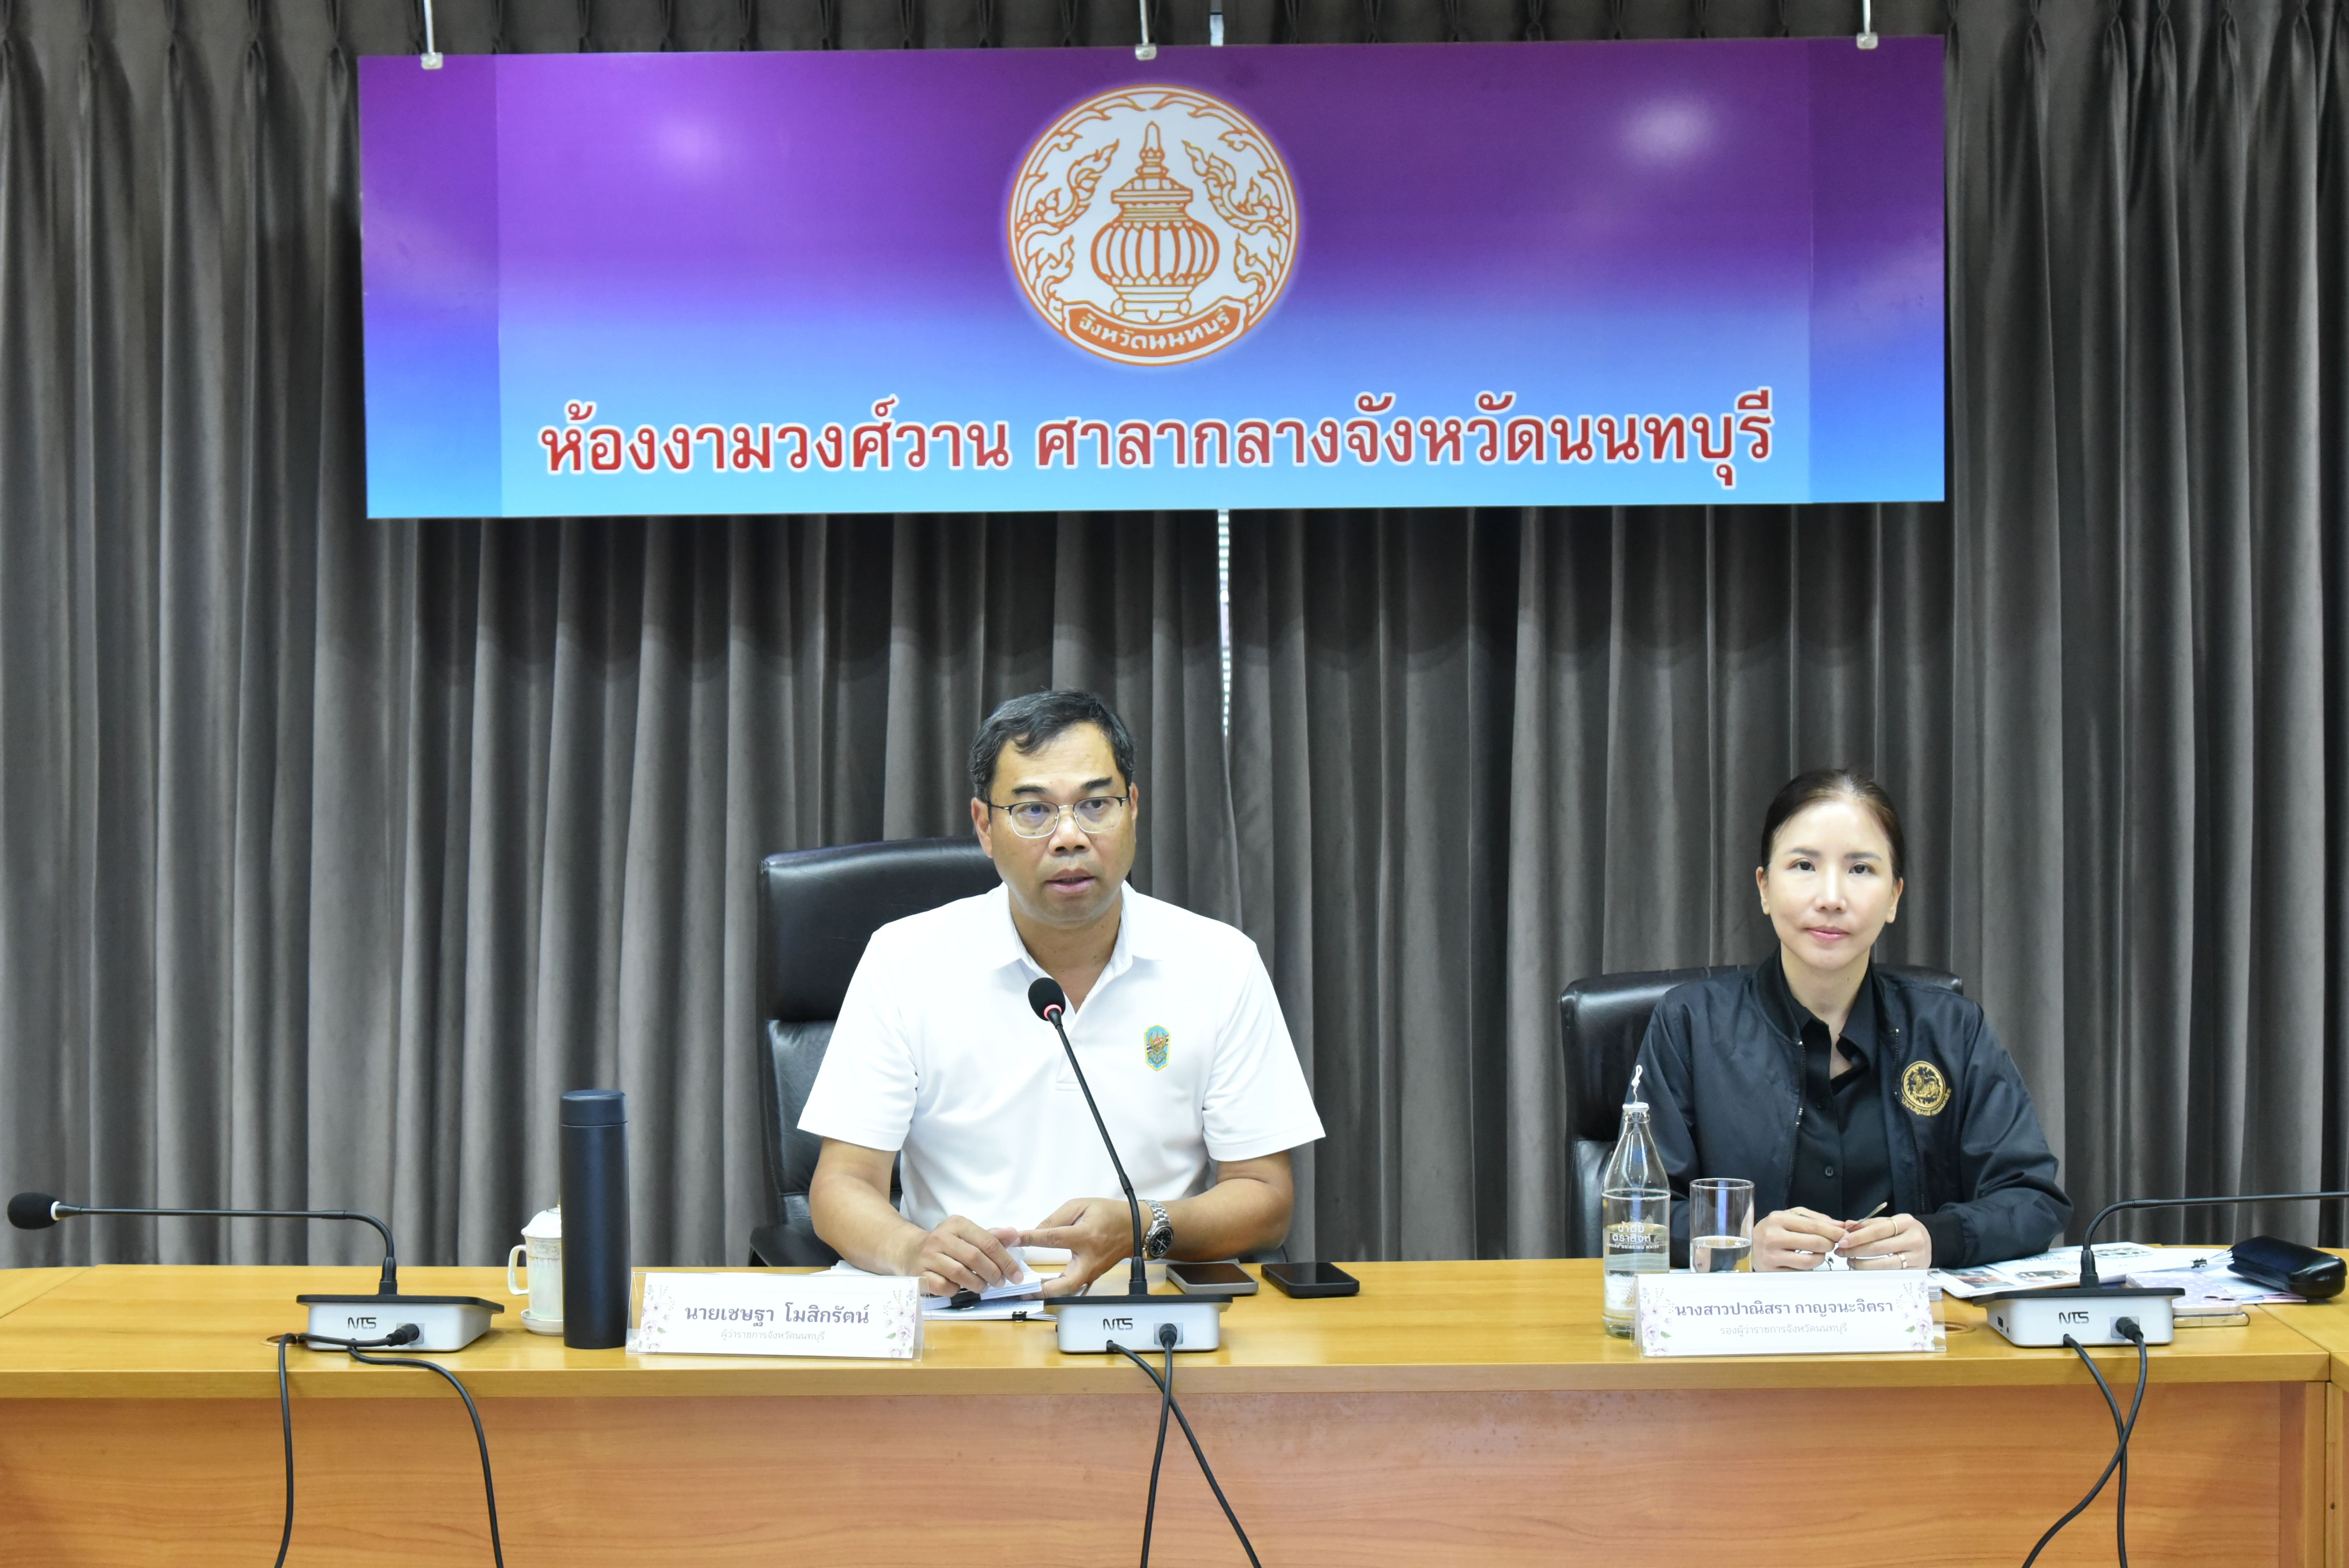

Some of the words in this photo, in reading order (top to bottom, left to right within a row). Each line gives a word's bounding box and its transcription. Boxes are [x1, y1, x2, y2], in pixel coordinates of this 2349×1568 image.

[1078, 307, 1231, 350] จังหวัดนนทบุรี
[540, 398, 1010, 472] ห้องงามวงศ์วาน
[1038, 388, 1772, 486] ศาลากลางจังหวัดนนทบุรี
[685, 1307, 774, 1327] นายเชษฐา
[785, 1302, 870, 1324] โมสิกรัตน์
[1675, 1300, 1790, 1316] นางสาวปาณิสรา
[1795, 1298, 1893, 1317] กาญจนะจิตรา
[348, 1317, 377, 1329] NTS
[1103, 1318, 1133, 1331] NTS
[2058, 1311, 2089, 1324] NTS
[721, 1328, 825, 1343] ผู้ว่าราชการจังหวัดนนทบุรี
[1720, 1322, 1847, 1337] รองผู้ว่าราชการจังหวัดนนทบุรี
